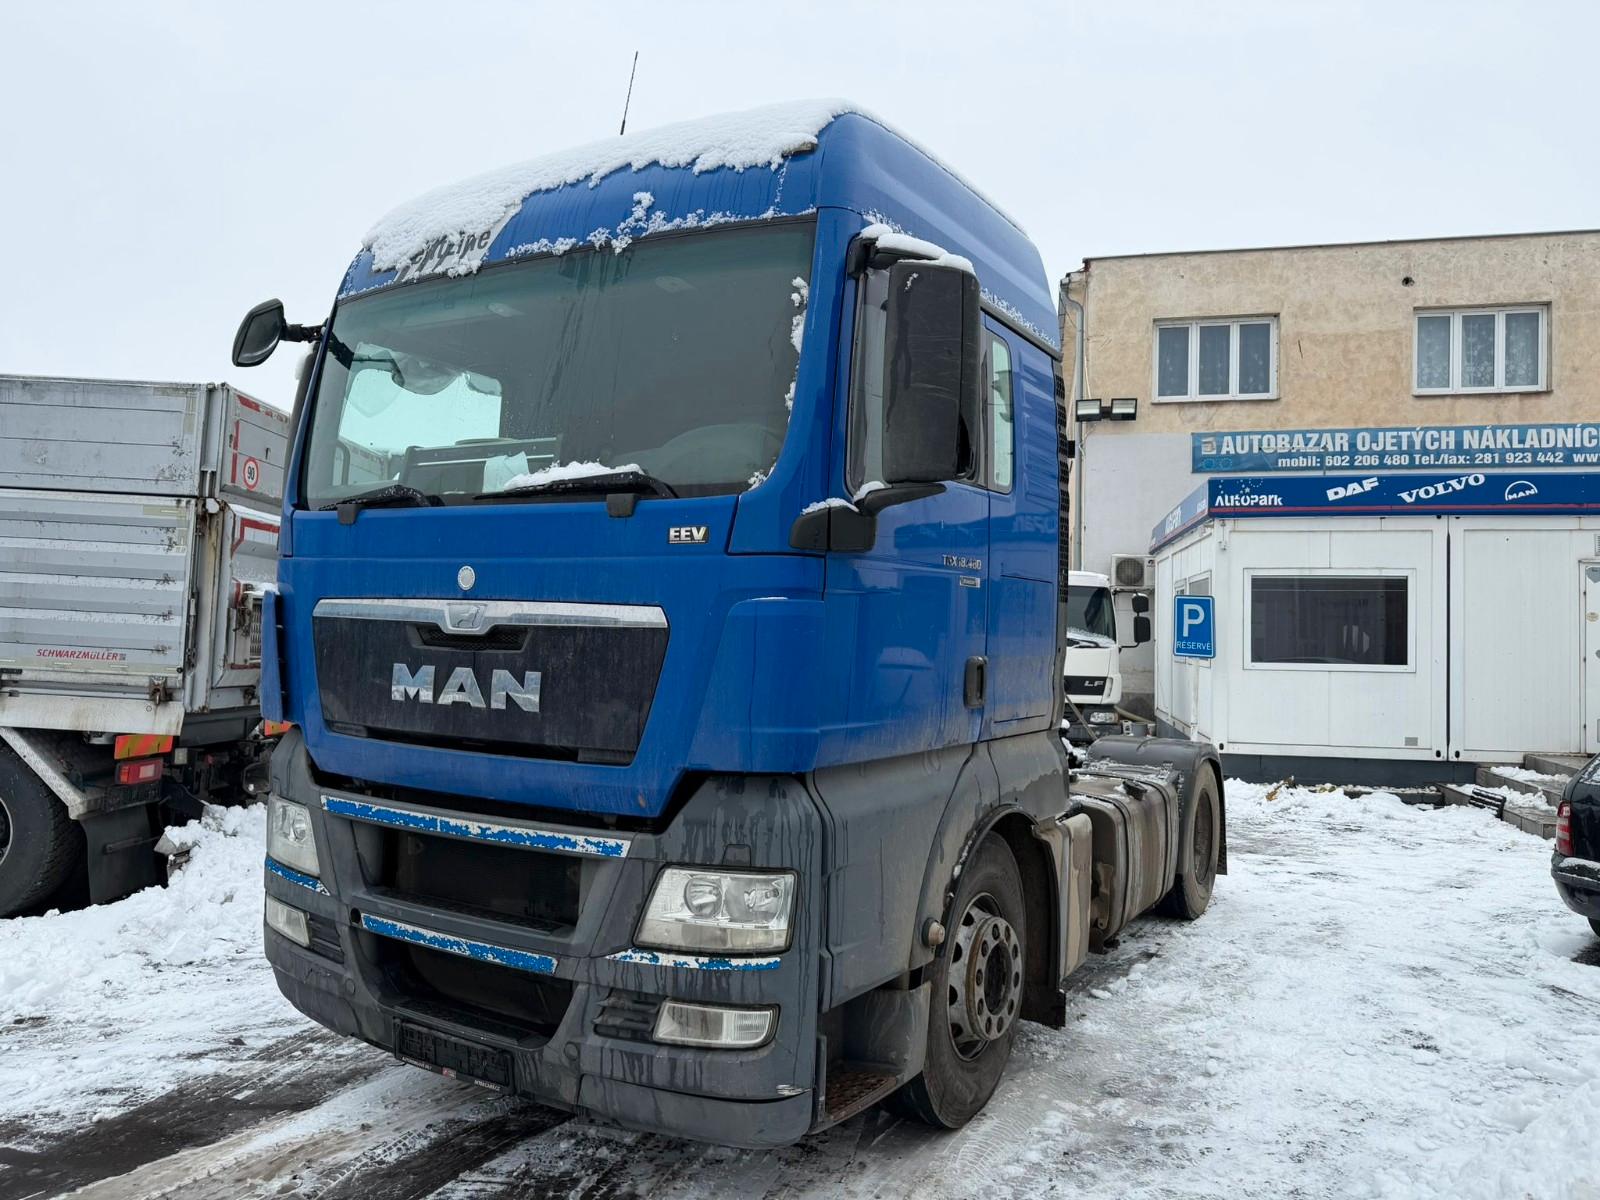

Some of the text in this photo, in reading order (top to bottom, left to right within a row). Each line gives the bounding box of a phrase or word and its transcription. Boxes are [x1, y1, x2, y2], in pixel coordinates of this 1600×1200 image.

[1220, 424, 1600, 455] AUTOBAZAR OJETÝCH NÁKLADNÍC
[1278, 455, 1321, 467] mobil:
[1325, 455, 1350, 466] 602
[1354, 455, 1379, 465] 206
[1383, 454, 1409, 465] 480
[1474, 453, 1499, 464] 281
[1505, 452, 1532, 463] 923
[1536, 452, 1564, 463] 442
[1573, 453, 1600, 462] ww
[1326, 477, 1379, 501] DAF
[1397, 473, 1485, 503] VOLVO
[1507, 488, 1536, 500] MAN
[669, 526, 707, 541] EEV
[1183, 604, 1205, 637] P
[36, 648, 118, 661] SCHWARZMÜLLER
[391, 663, 542, 713] MAN
